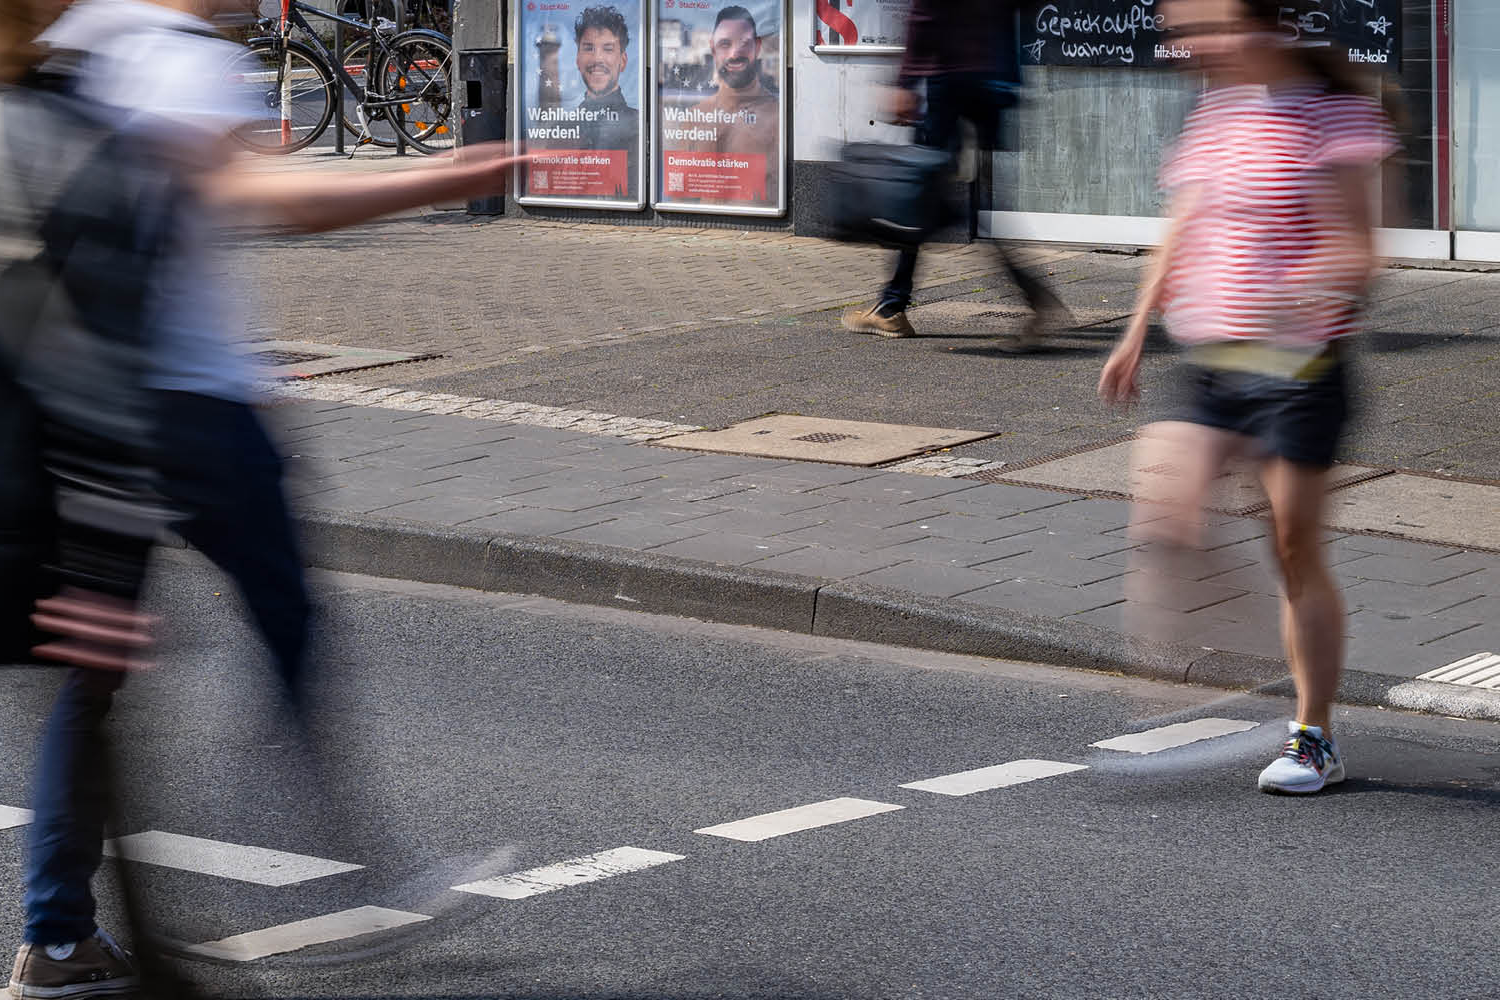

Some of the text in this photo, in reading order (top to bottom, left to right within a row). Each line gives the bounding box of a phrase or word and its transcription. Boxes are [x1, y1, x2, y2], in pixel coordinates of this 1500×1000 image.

[1154, 44, 1191, 59] fritz-kola
[1348, 48, 1388, 64] fritz-kola
[528, 125, 580, 139] werden!
[664, 127, 717, 141] werden!
[579, 155, 611, 165] stärken
[668, 156, 749, 168] Demokratie stärken
